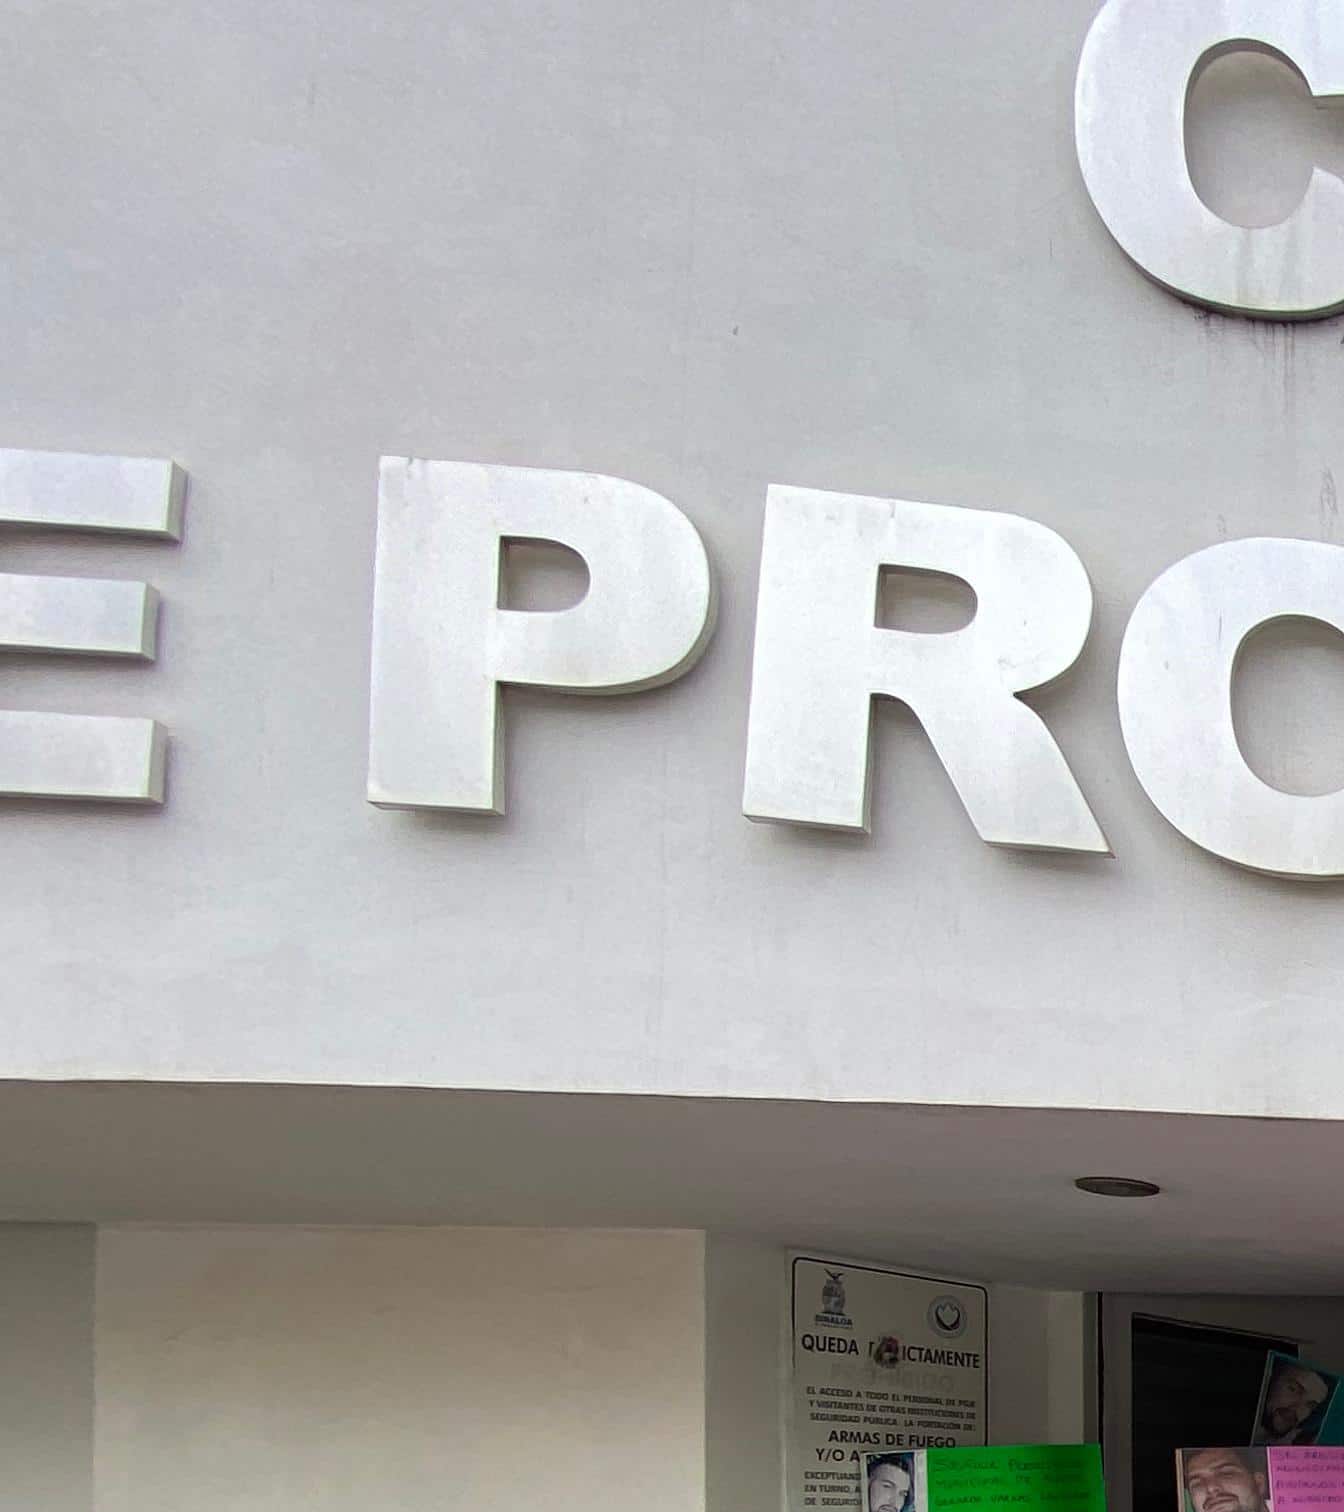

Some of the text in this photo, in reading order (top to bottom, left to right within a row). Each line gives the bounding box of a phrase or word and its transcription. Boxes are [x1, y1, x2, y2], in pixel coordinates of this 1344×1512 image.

[801, 1334, 981, 1369] QUEDA ICTAMENTE
[828, 1430, 956, 1449] ARMAS DE FUEGO
[816, 1448, 845, 1463] Y/O
